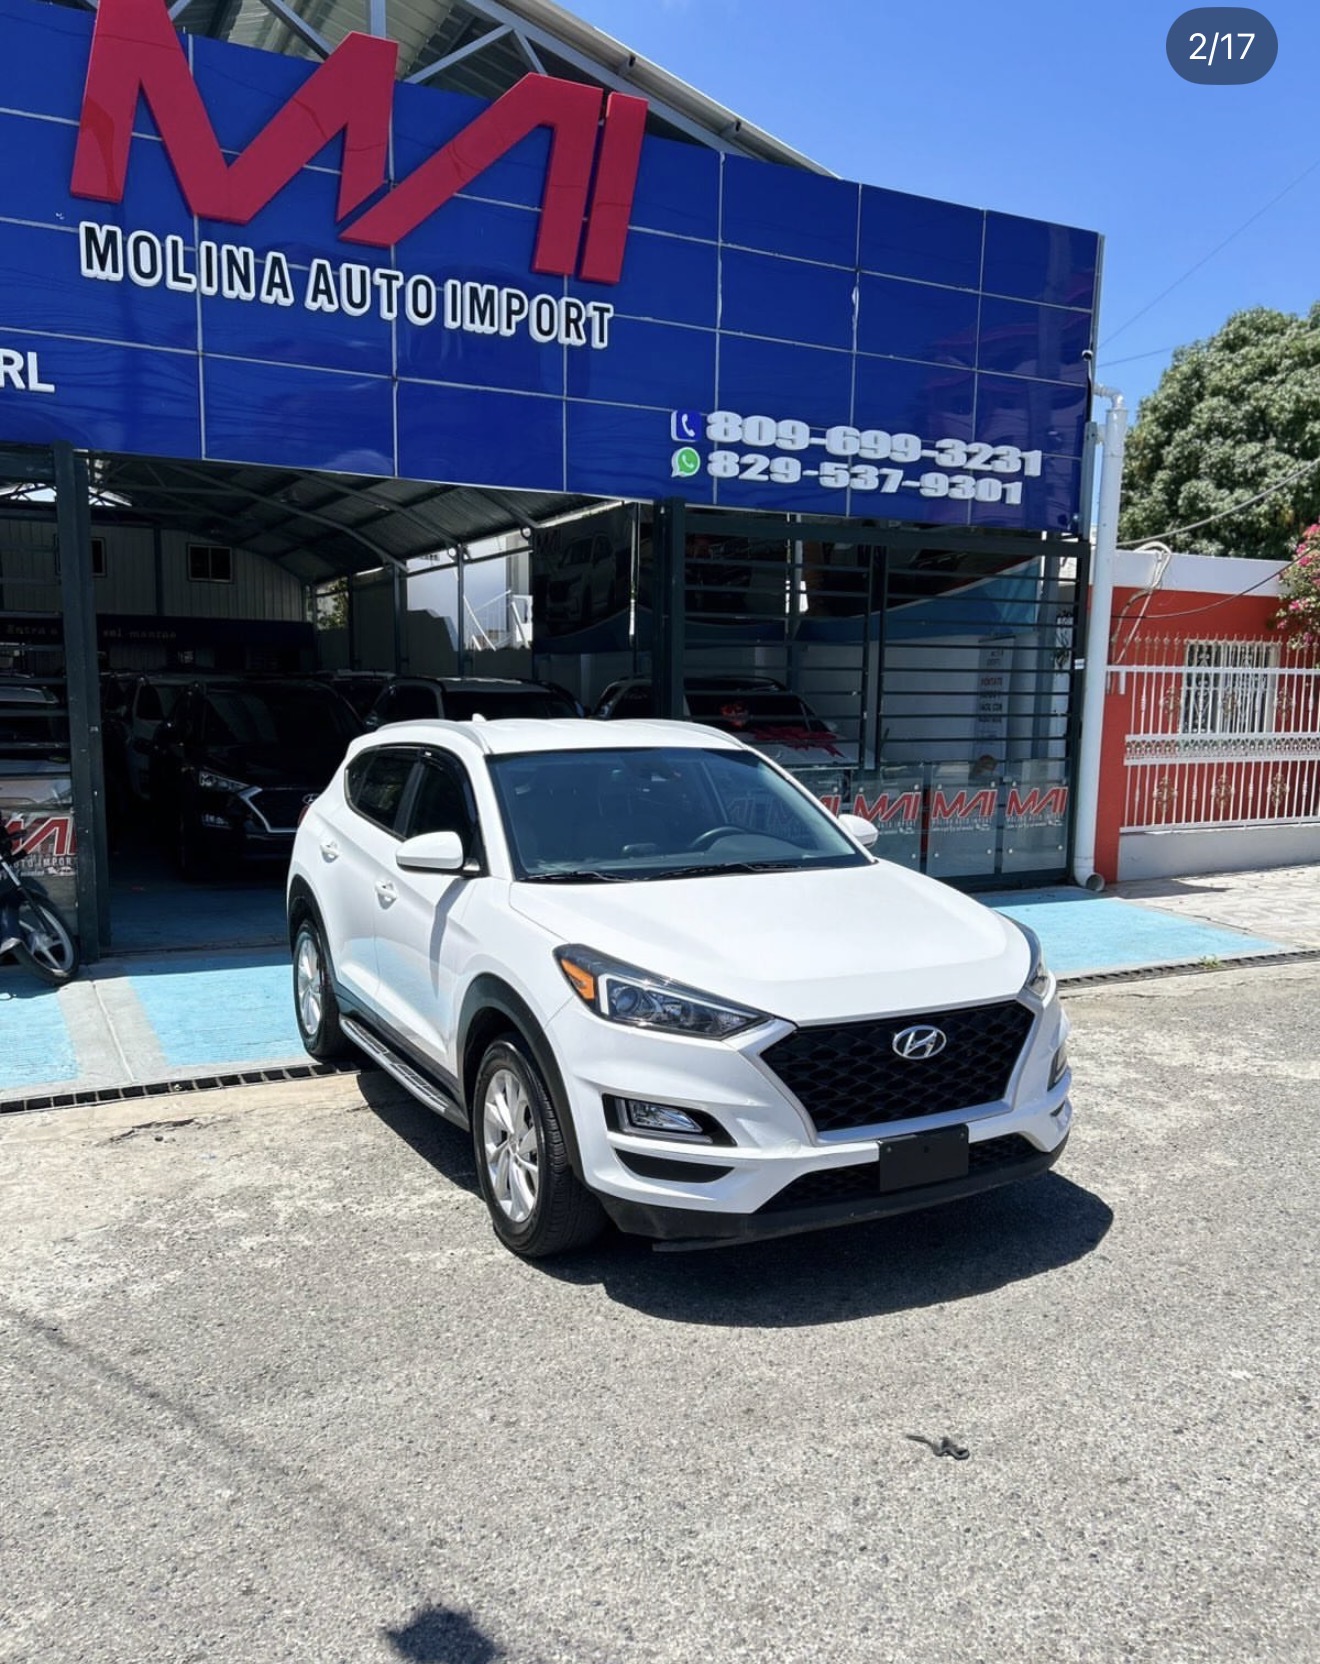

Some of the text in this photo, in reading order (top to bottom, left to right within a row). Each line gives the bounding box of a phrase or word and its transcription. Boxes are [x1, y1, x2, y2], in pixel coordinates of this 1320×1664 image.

[79, 221, 615, 350] MOLINA AUTO IMPORT
[706, 410, 1043, 478] 809-699-3231
[707, 449, 1023, 505] 829-537-9301
[931, 789, 998, 819] MAI
[1005, 786, 1069, 816] MAI
